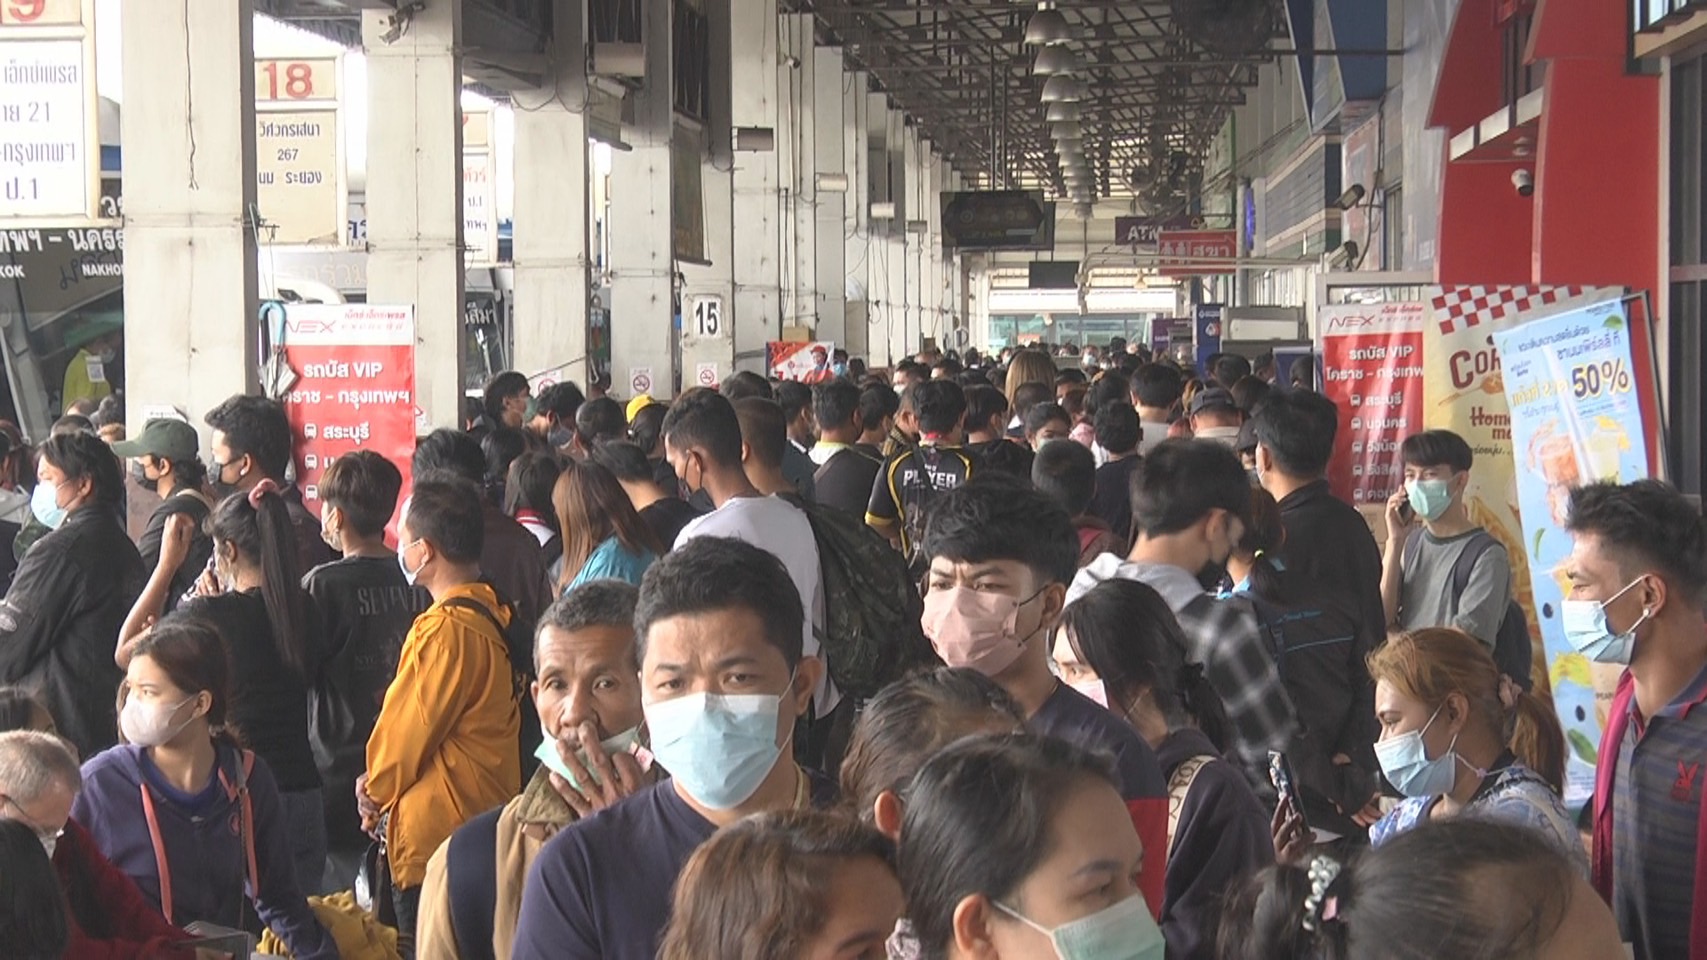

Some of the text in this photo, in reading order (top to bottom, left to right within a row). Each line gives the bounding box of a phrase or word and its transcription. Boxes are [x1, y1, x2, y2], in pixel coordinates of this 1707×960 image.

[263, 62, 313, 100] 18
[28, 101, 50, 122] 21
[277, 148, 299, 161] 267
[6, 176, 37, 200] ป.1
[285, 171, 323, 185] ระยอง
[1127, 225, 1163, 241] ATM
[695, 301, 718, 335] 15
[1348, 345, 1413, 361] รถบัส VIP
[303, 360, 383, 378] รถบัส VIP
[1326, 367, 1364, 381] โคราช
[1572, 357, 1629, 399] 50%
[338, 390, 411, 410] กรุงเทพฯ
[323, 421, 370, 445] สระบุรี
[903, 469, 957, 490] PLYER
